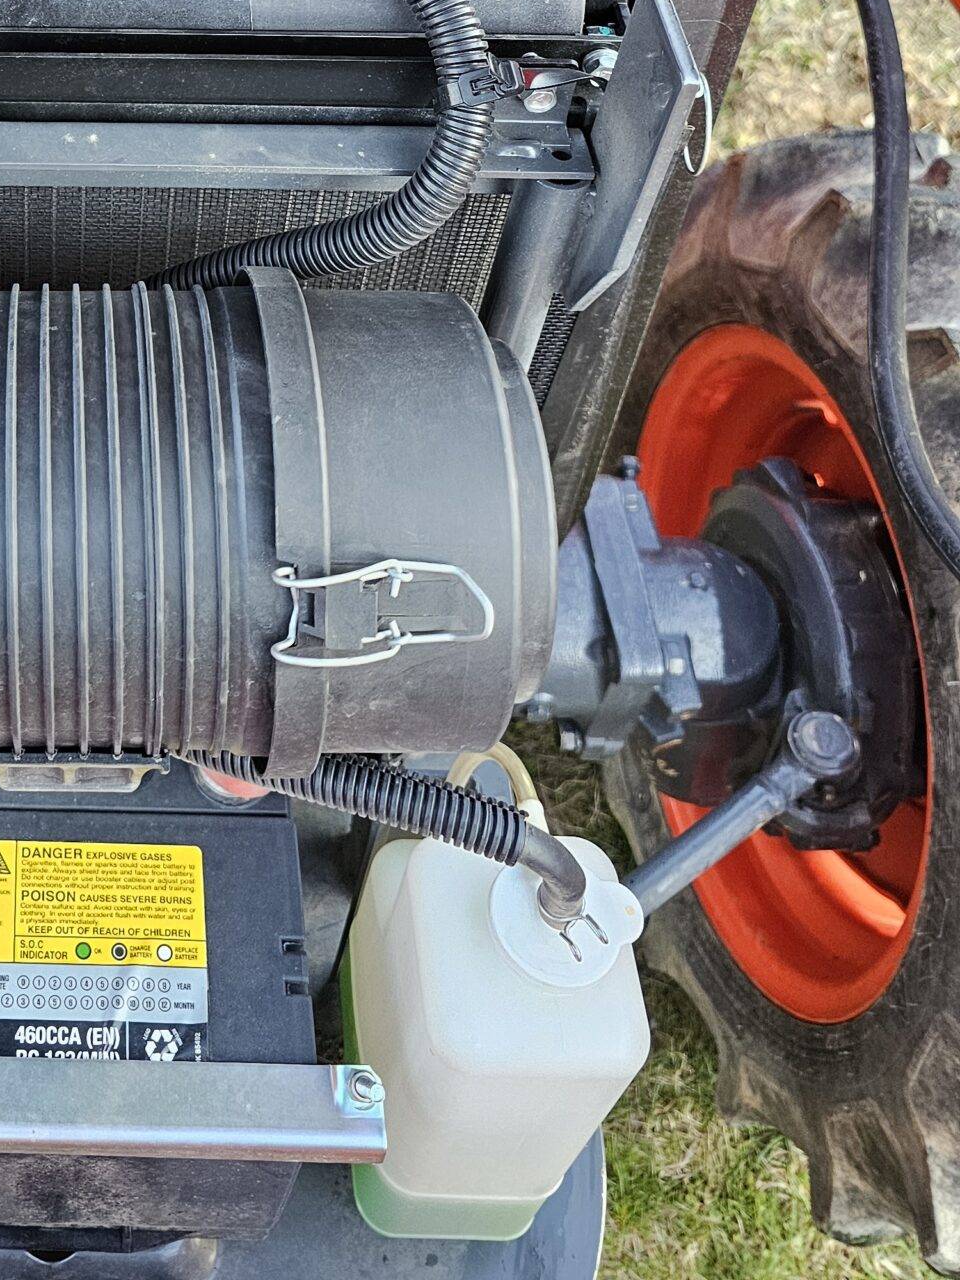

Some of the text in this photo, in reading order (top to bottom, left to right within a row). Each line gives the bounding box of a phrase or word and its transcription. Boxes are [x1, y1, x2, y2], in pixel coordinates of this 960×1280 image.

[22, 847, 172, 861] DANGER EXPLOSIVE GASES
[21, 890, 192, 905] POISON CAUSES SEVERE BURNS
[27, 926, 190, 938] KEEP OUT OF REACH OF CHILDREN
[20, 950, 68, 960] INDICATOR
[174, 1002, 195, 1010] MONTH
[15, 1025, 82, 1045] 460CCA
[86, 1026, 121, 1049] (EN)
